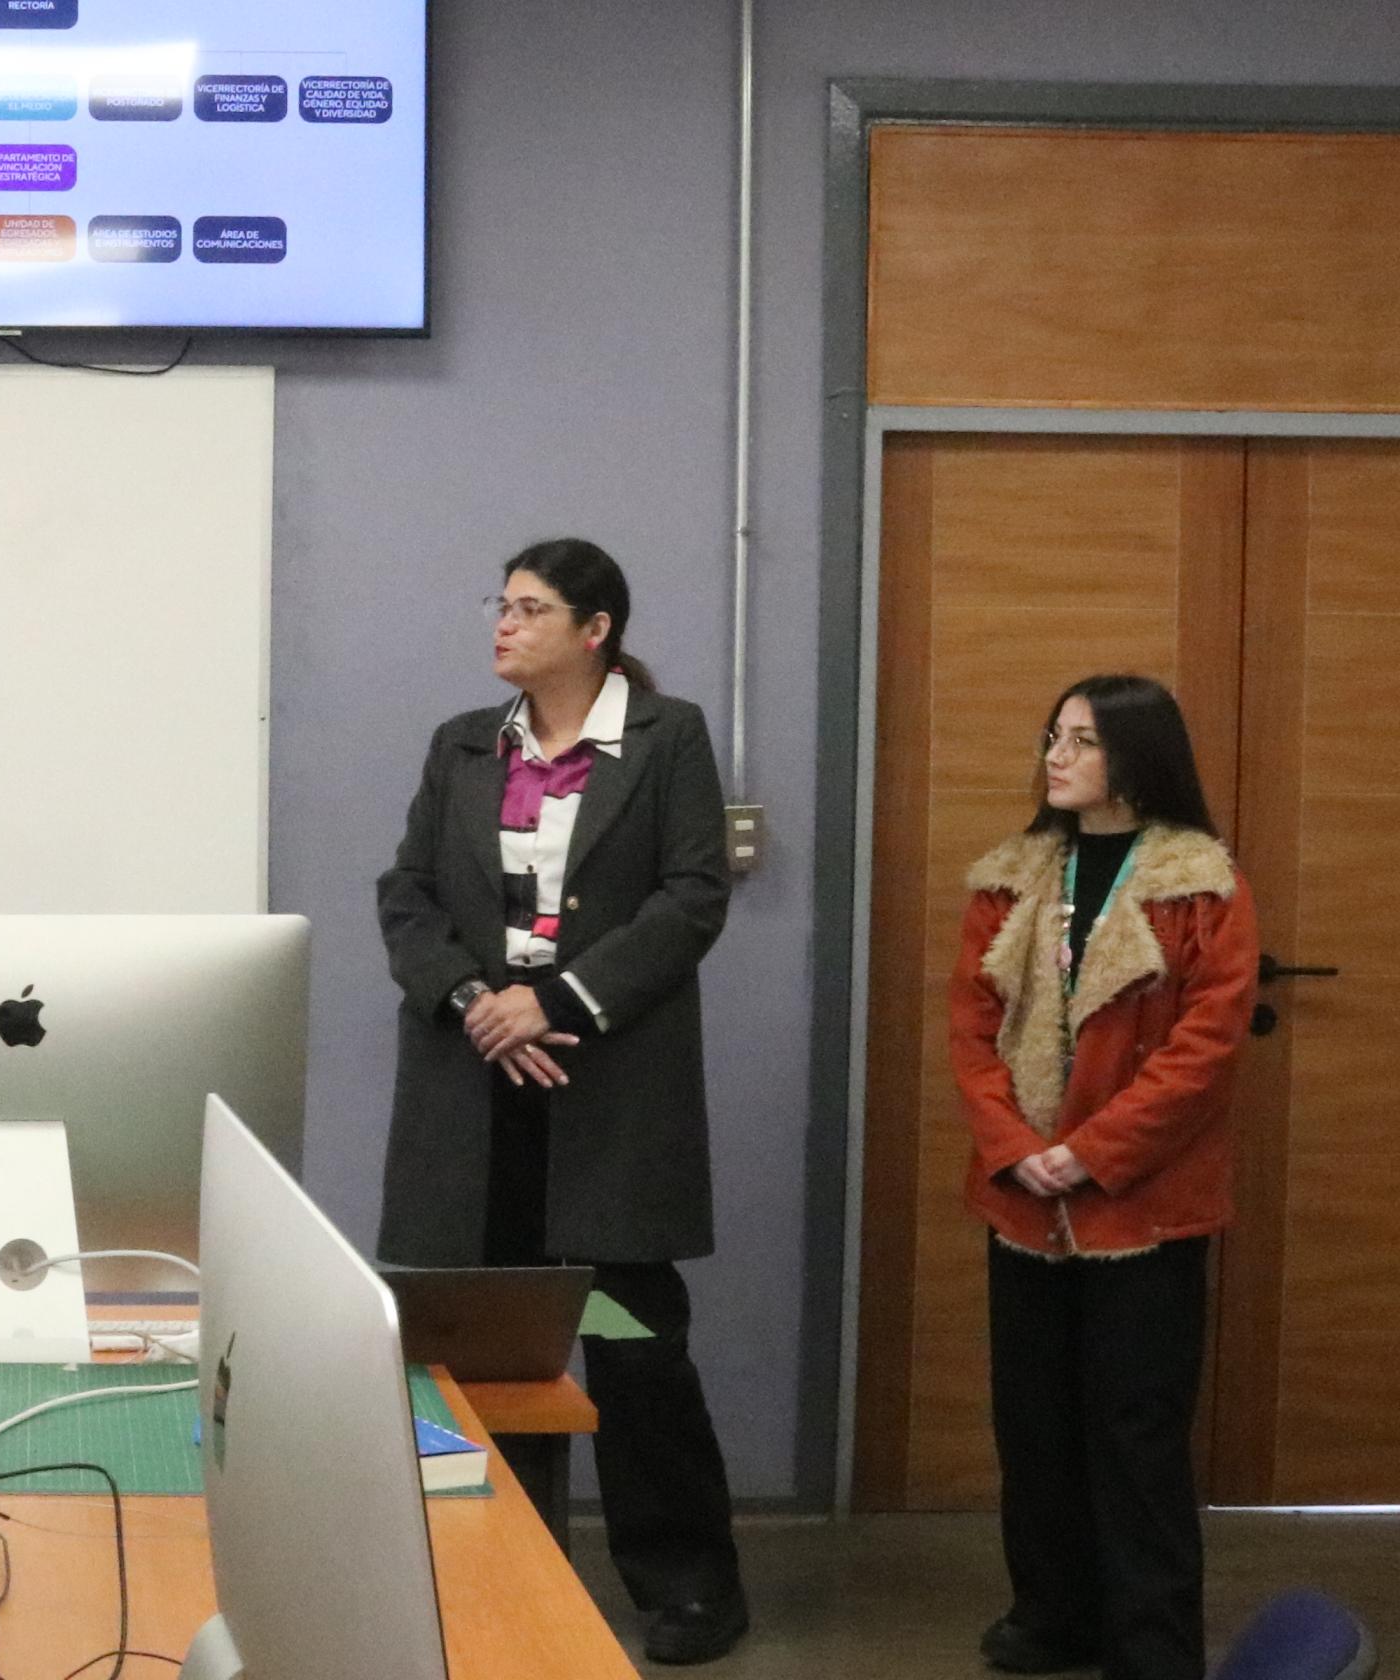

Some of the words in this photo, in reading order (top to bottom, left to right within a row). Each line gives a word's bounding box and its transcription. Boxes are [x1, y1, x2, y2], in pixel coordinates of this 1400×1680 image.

[197, 83, 270, 93] VICERRECTORÍA
[272, 85, 284, 93] DE
[302, 80, 375, 89] VICERRECTORÍA
[376, 81, 389, 90] DE
[214, 94, 259, 103] FINANZAS
[306, 90, 347, 98] CALIDAD
[347, 91, 360, 99] DE
[217, 102, 265, 112] LOGÍSTICA
[346, 101, 388, 109] EQUIDAD
[322, 109, 376, 118] DIVERSIDAD
[62, 154, 74, 162] DE
[133, 230, 177, 238] ESTUDIOS
[247, 230, 259, 238] DE
[196, 240, 284, 249] COMUNICACIONES
